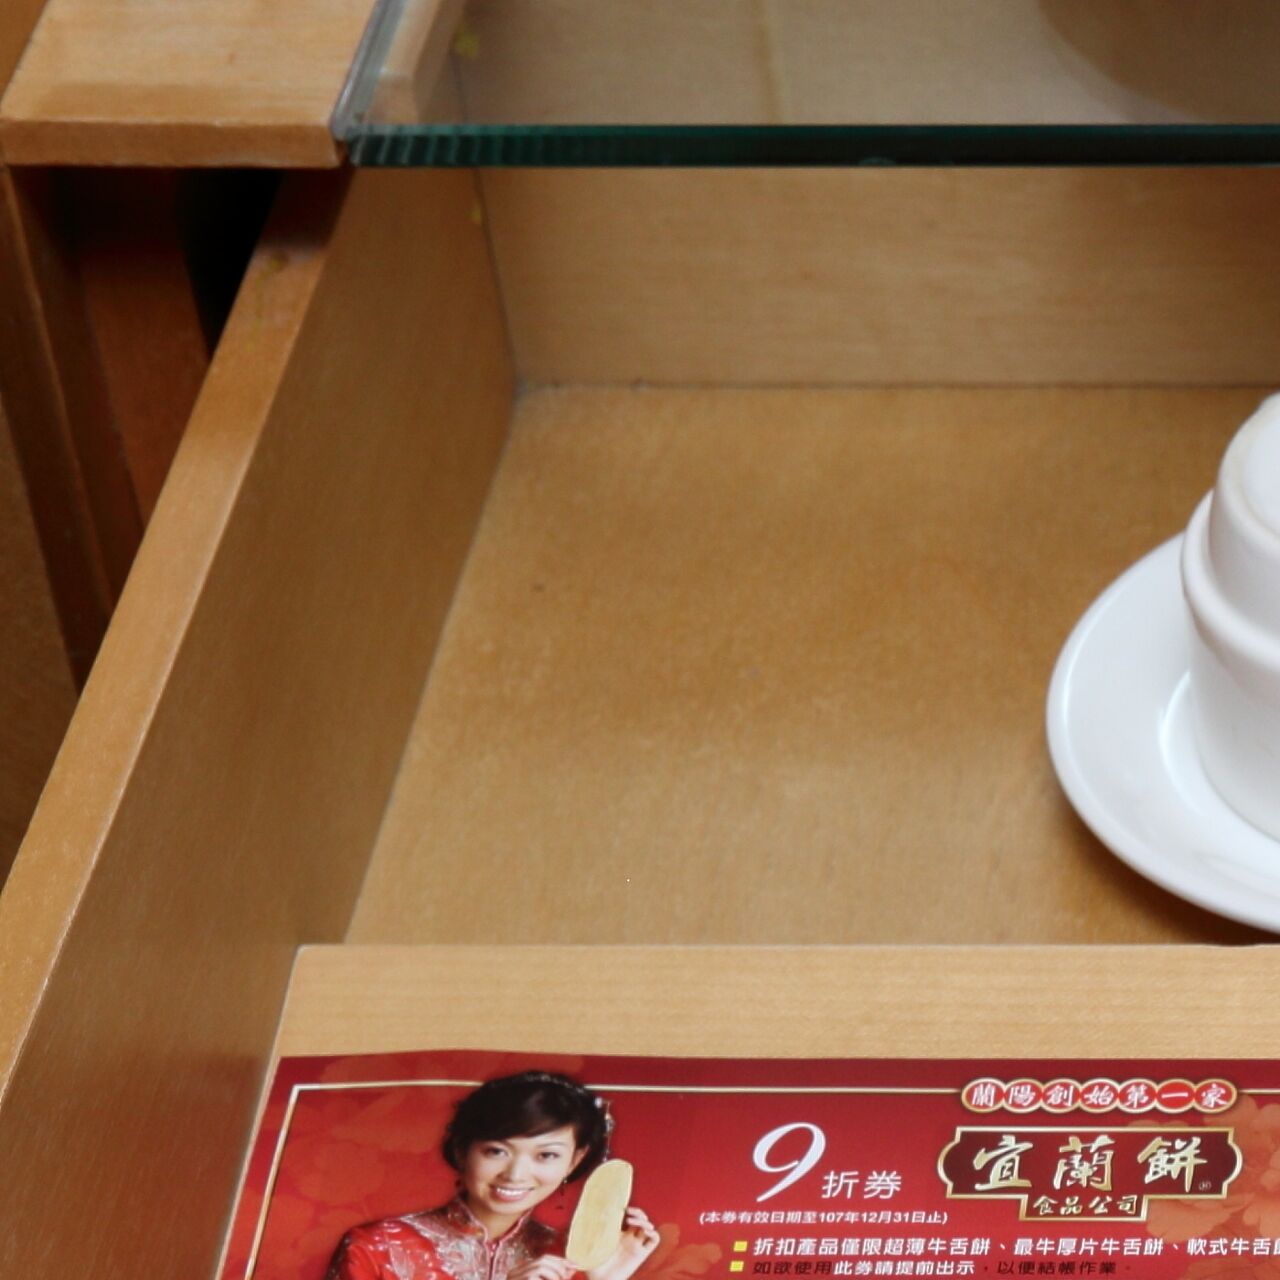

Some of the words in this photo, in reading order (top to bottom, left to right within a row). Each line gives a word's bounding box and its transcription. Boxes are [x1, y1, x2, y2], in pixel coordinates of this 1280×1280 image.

[971, 1081, 1228, 1109] 蘭陽創始第一家
[753, 1122, 903, 1202] 9折券
[972, 1134, 1209, 1193] 宜蘭餅
[1033, 1194, 1139, 1216] 食品公司
